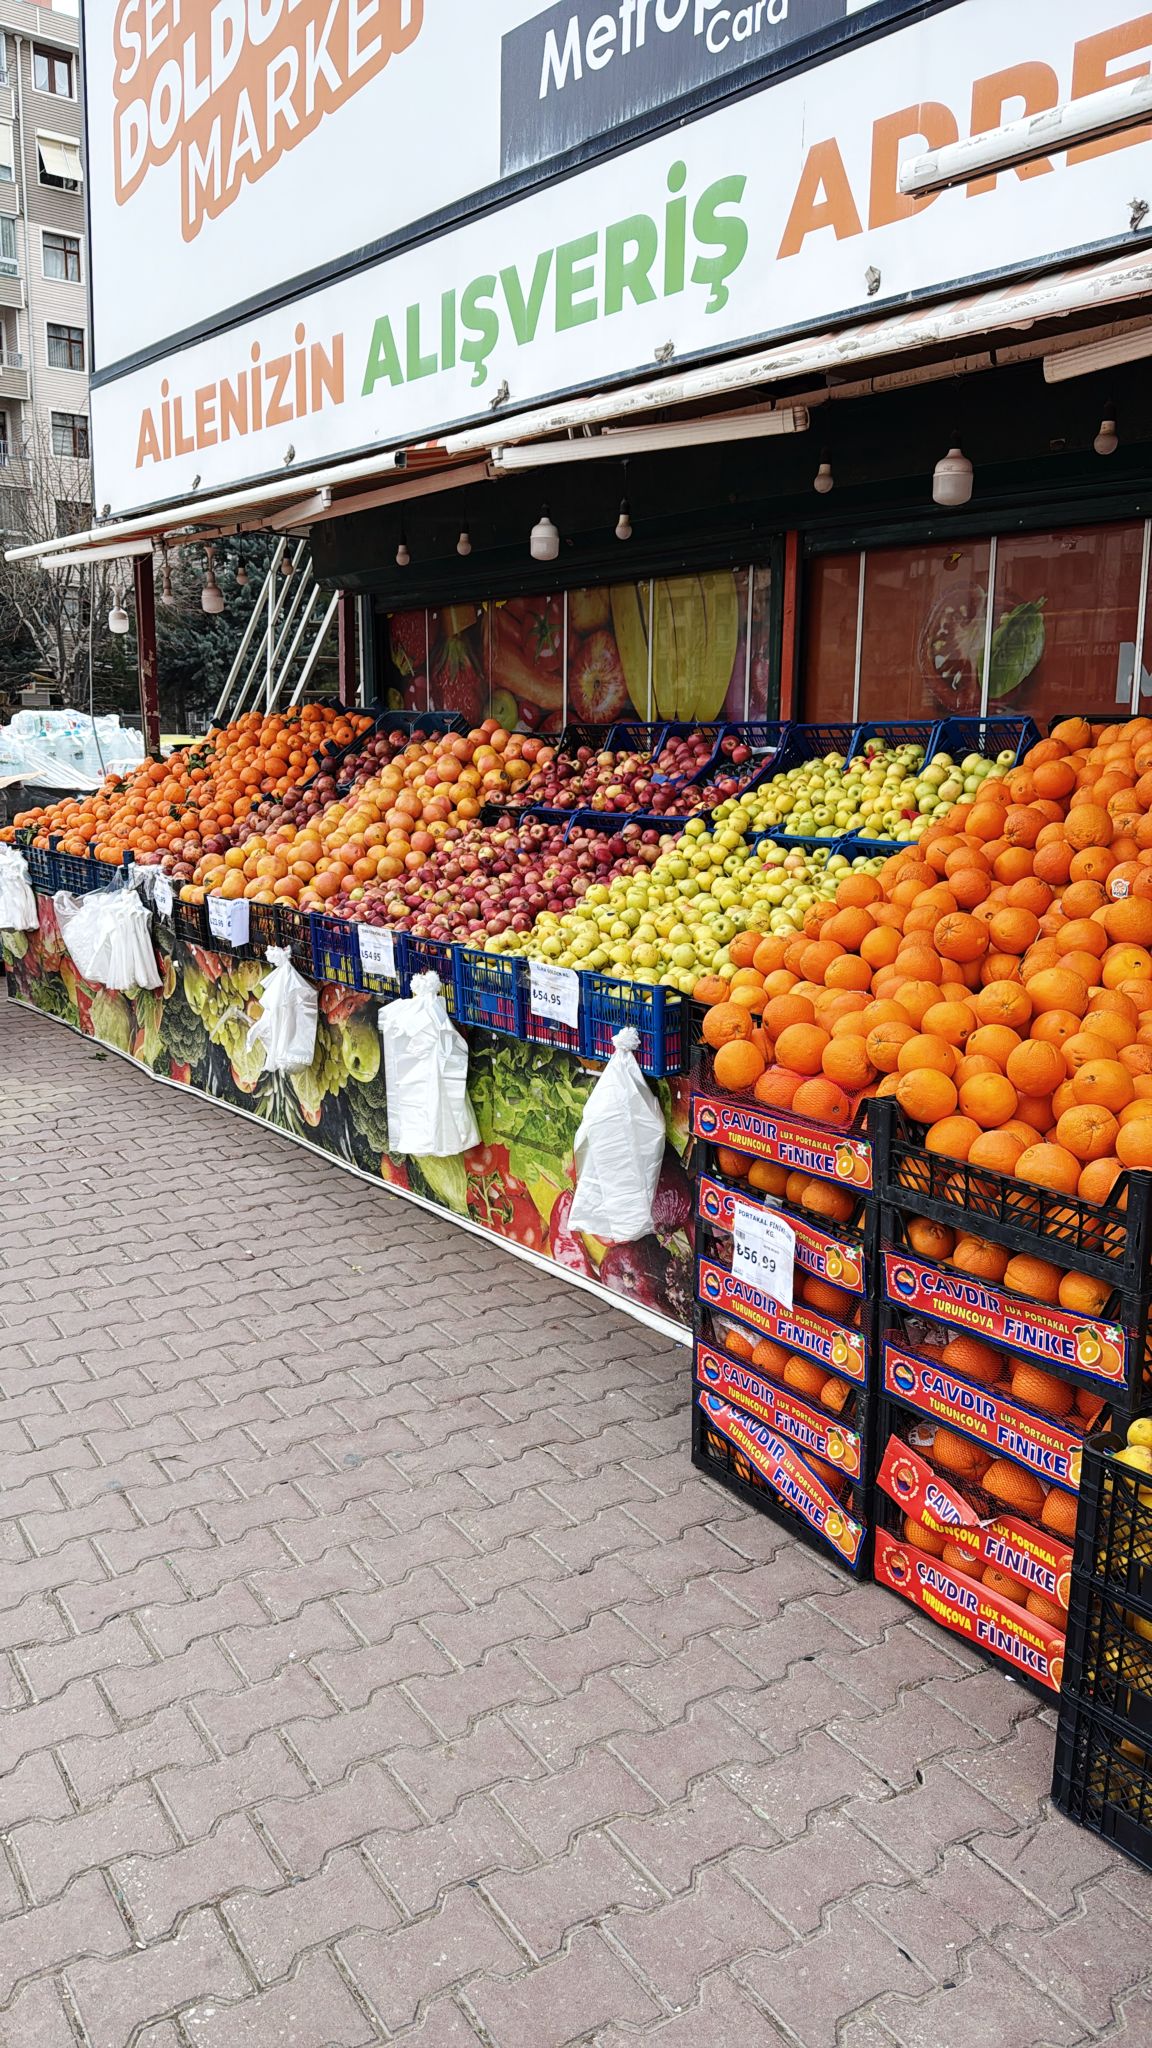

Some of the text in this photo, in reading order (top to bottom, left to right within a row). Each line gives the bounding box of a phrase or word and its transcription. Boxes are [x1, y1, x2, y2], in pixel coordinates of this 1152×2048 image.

[135, 322, 345, 469] AİLENİZİN
[361, 159, 748, 397] ALIŞVERİŞ
[532, 989, 561, 1006] ₺54.95
[720, 1110, 777, 1140] ÇAVDIR
[795, 1134, 832, 1152] PORTAKAL
[738, 1209, 768, 1226] PORTAKAL
[736, 1243, 776, 1273] ₺56.99
[724, 1277, 777, 1318] ÇAVDIR
[920, 1271, 1002, 1316] ÇAVDIR
[795, 1314, 830, 1337] PORTAKAL
[1024, 1310, 1070, 1335] PORTAKAL
[722, 1362, 775, 1407] ÇAVDIR
[920, 1369, 997, 1423] ÇAVDIR
[791, 1404, 824, 1433] PORTAKAL
[1019, 1422, 1065, 1451] PORTAKAL
[794, 1472, 826, 1508] PORTAKAL
[984, 1535, 1056, 1595] FİNİKE
[1011, 1533, 1057, 1568] PORTAKAL
[916, 1561, 979, 1616] ÇAVDIR
[921, 1588, 972, 1632] TURUNÇOVA
[976, 1618, 1049, 1677] FİNİKE
[1000, 1615, 1047, 1652] PORTAKAL
